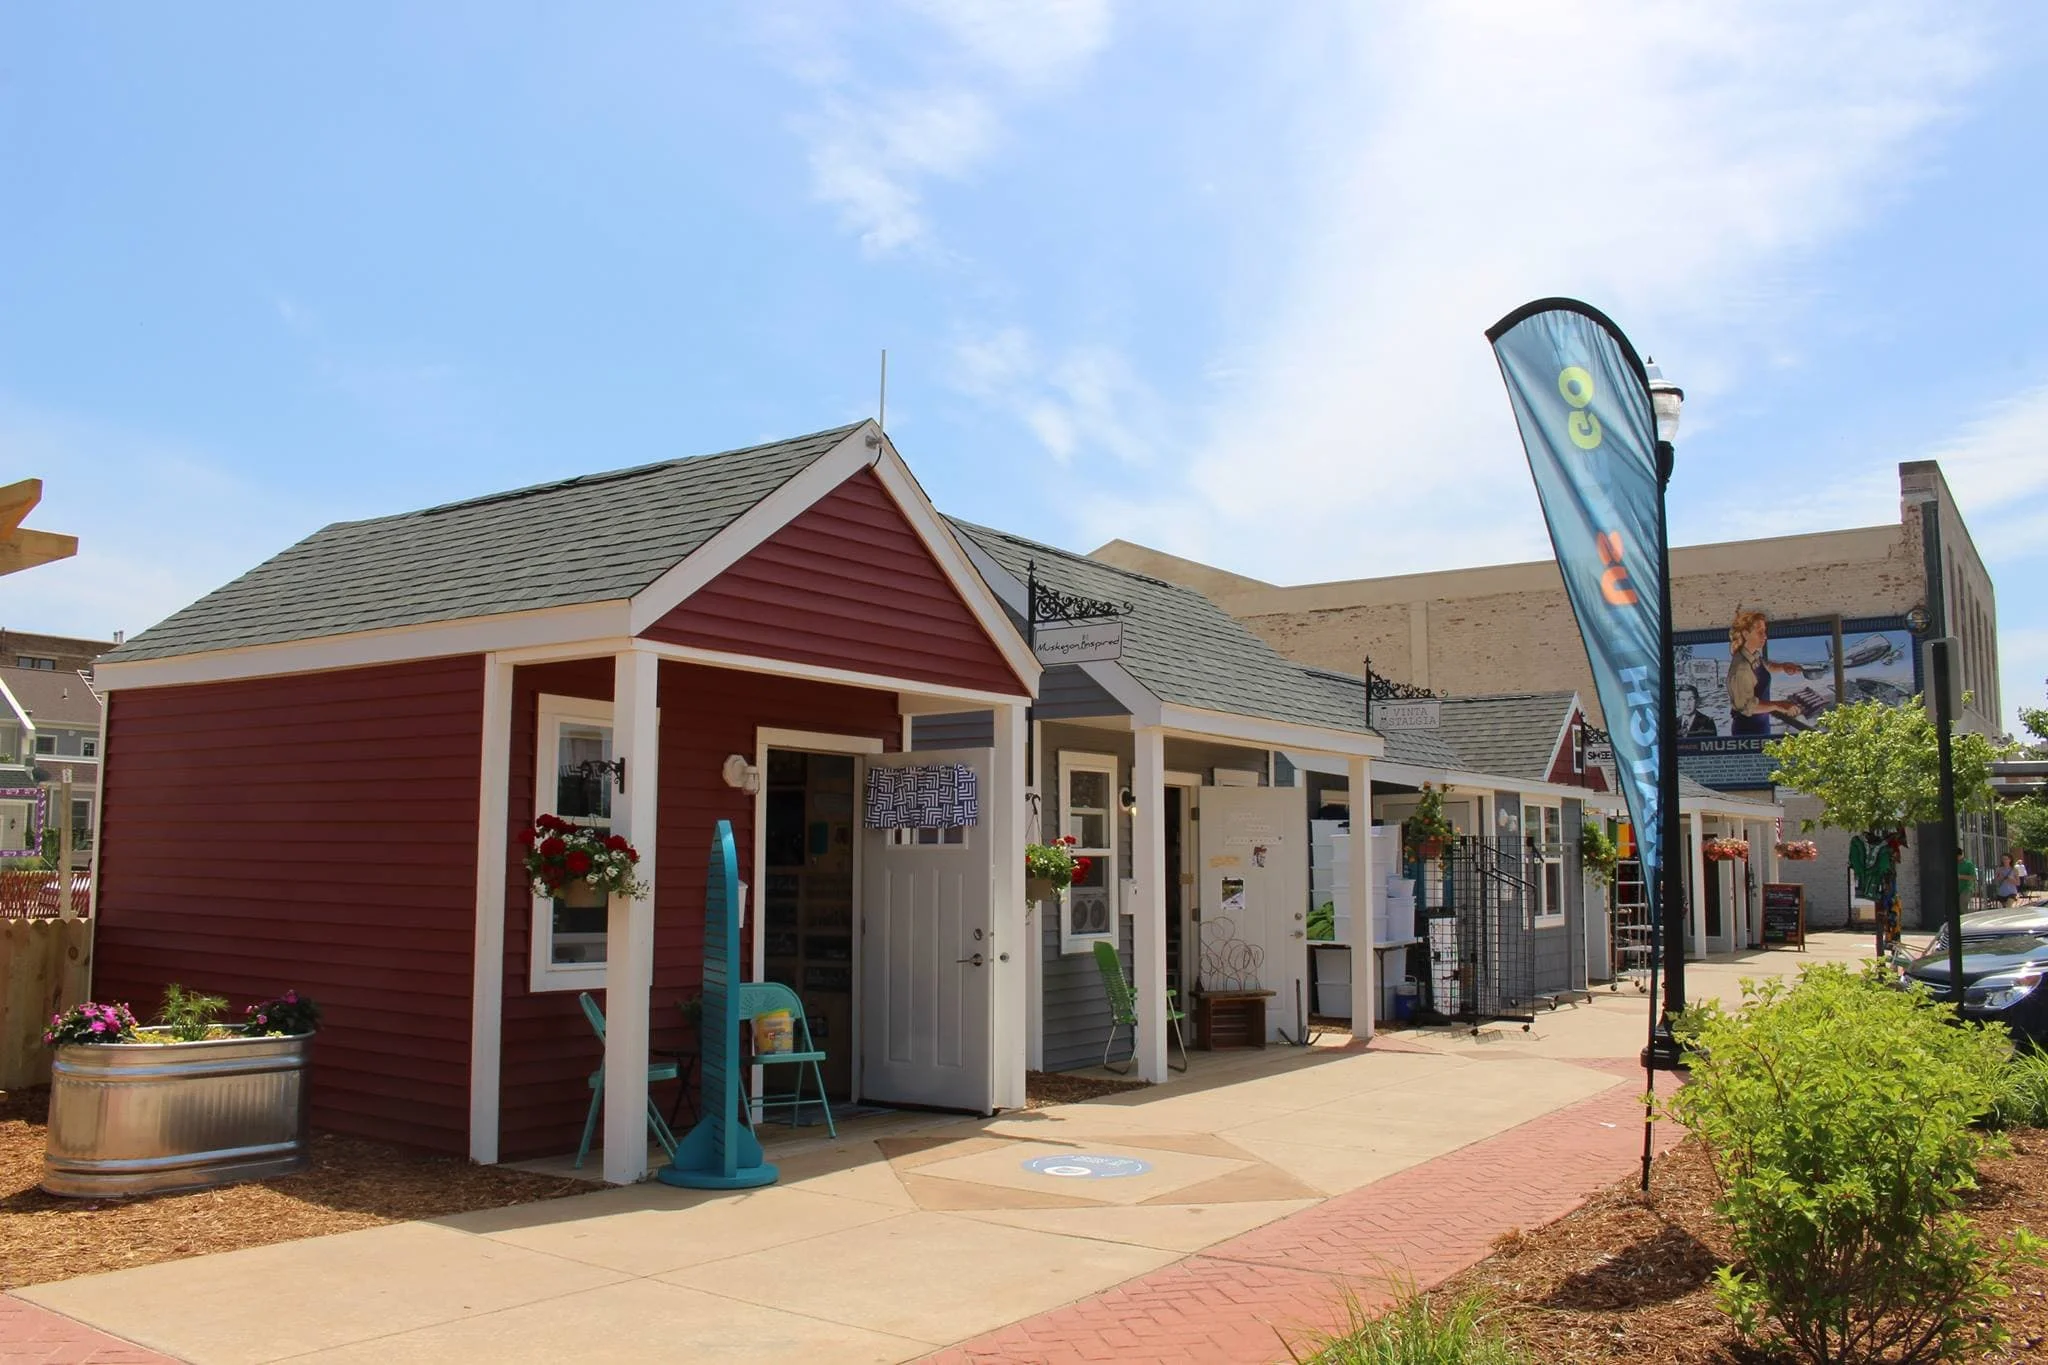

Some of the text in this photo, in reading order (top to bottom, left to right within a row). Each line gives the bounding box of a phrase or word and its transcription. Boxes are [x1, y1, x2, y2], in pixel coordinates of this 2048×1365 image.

[1036, 641, 1082, 655] Muskegon
[1393, 708, 1428, 717] VINTA
[1700, 739, 1780, 752] MUSKE
